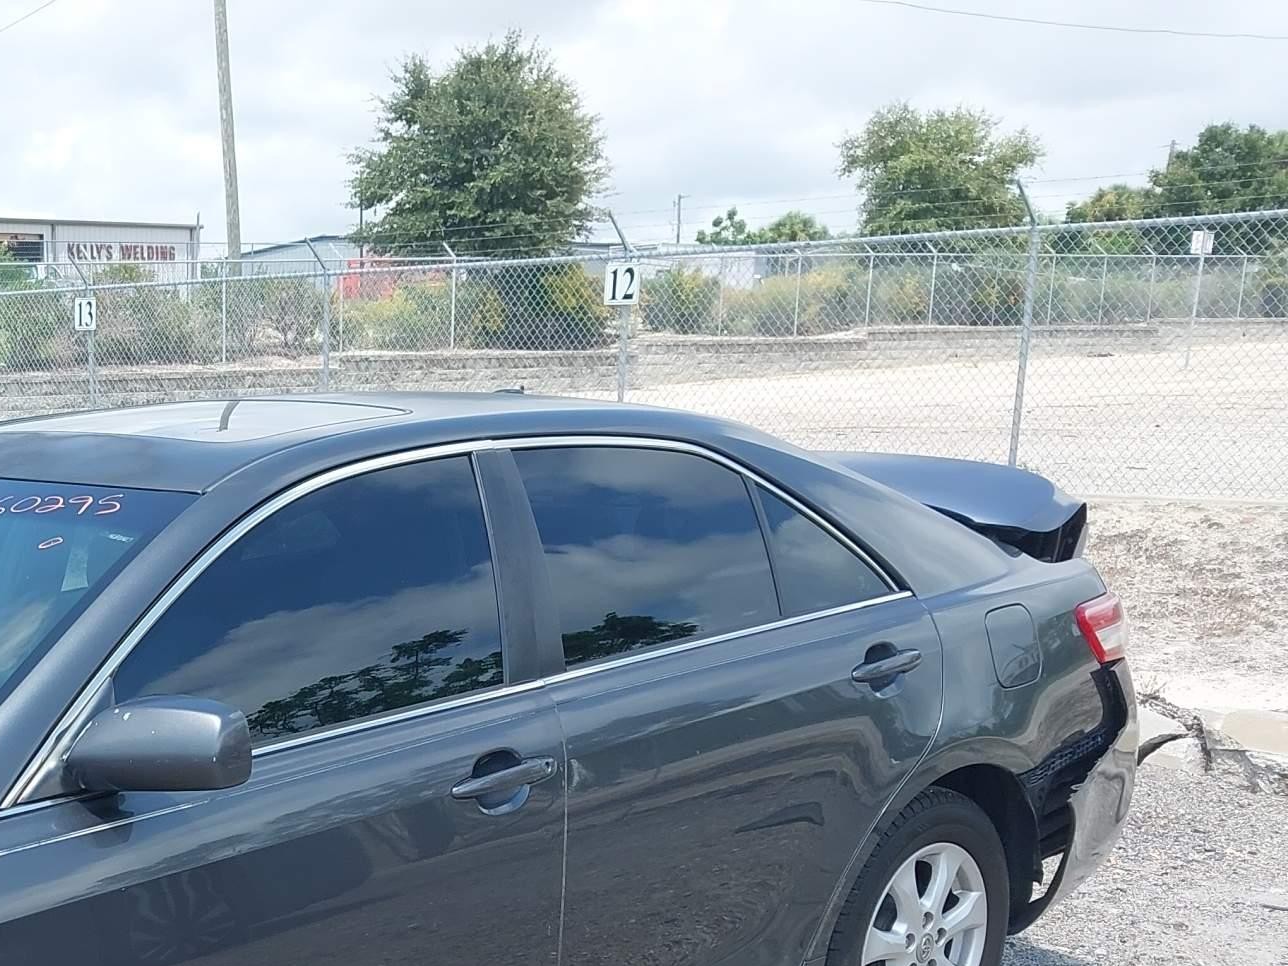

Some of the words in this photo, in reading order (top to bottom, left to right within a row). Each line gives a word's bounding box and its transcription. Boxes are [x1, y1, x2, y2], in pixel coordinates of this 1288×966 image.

[118, 244, 176, 262] WELDING
[608, 267, 635, 301] 12
[78, 301, 94, 328] 13
